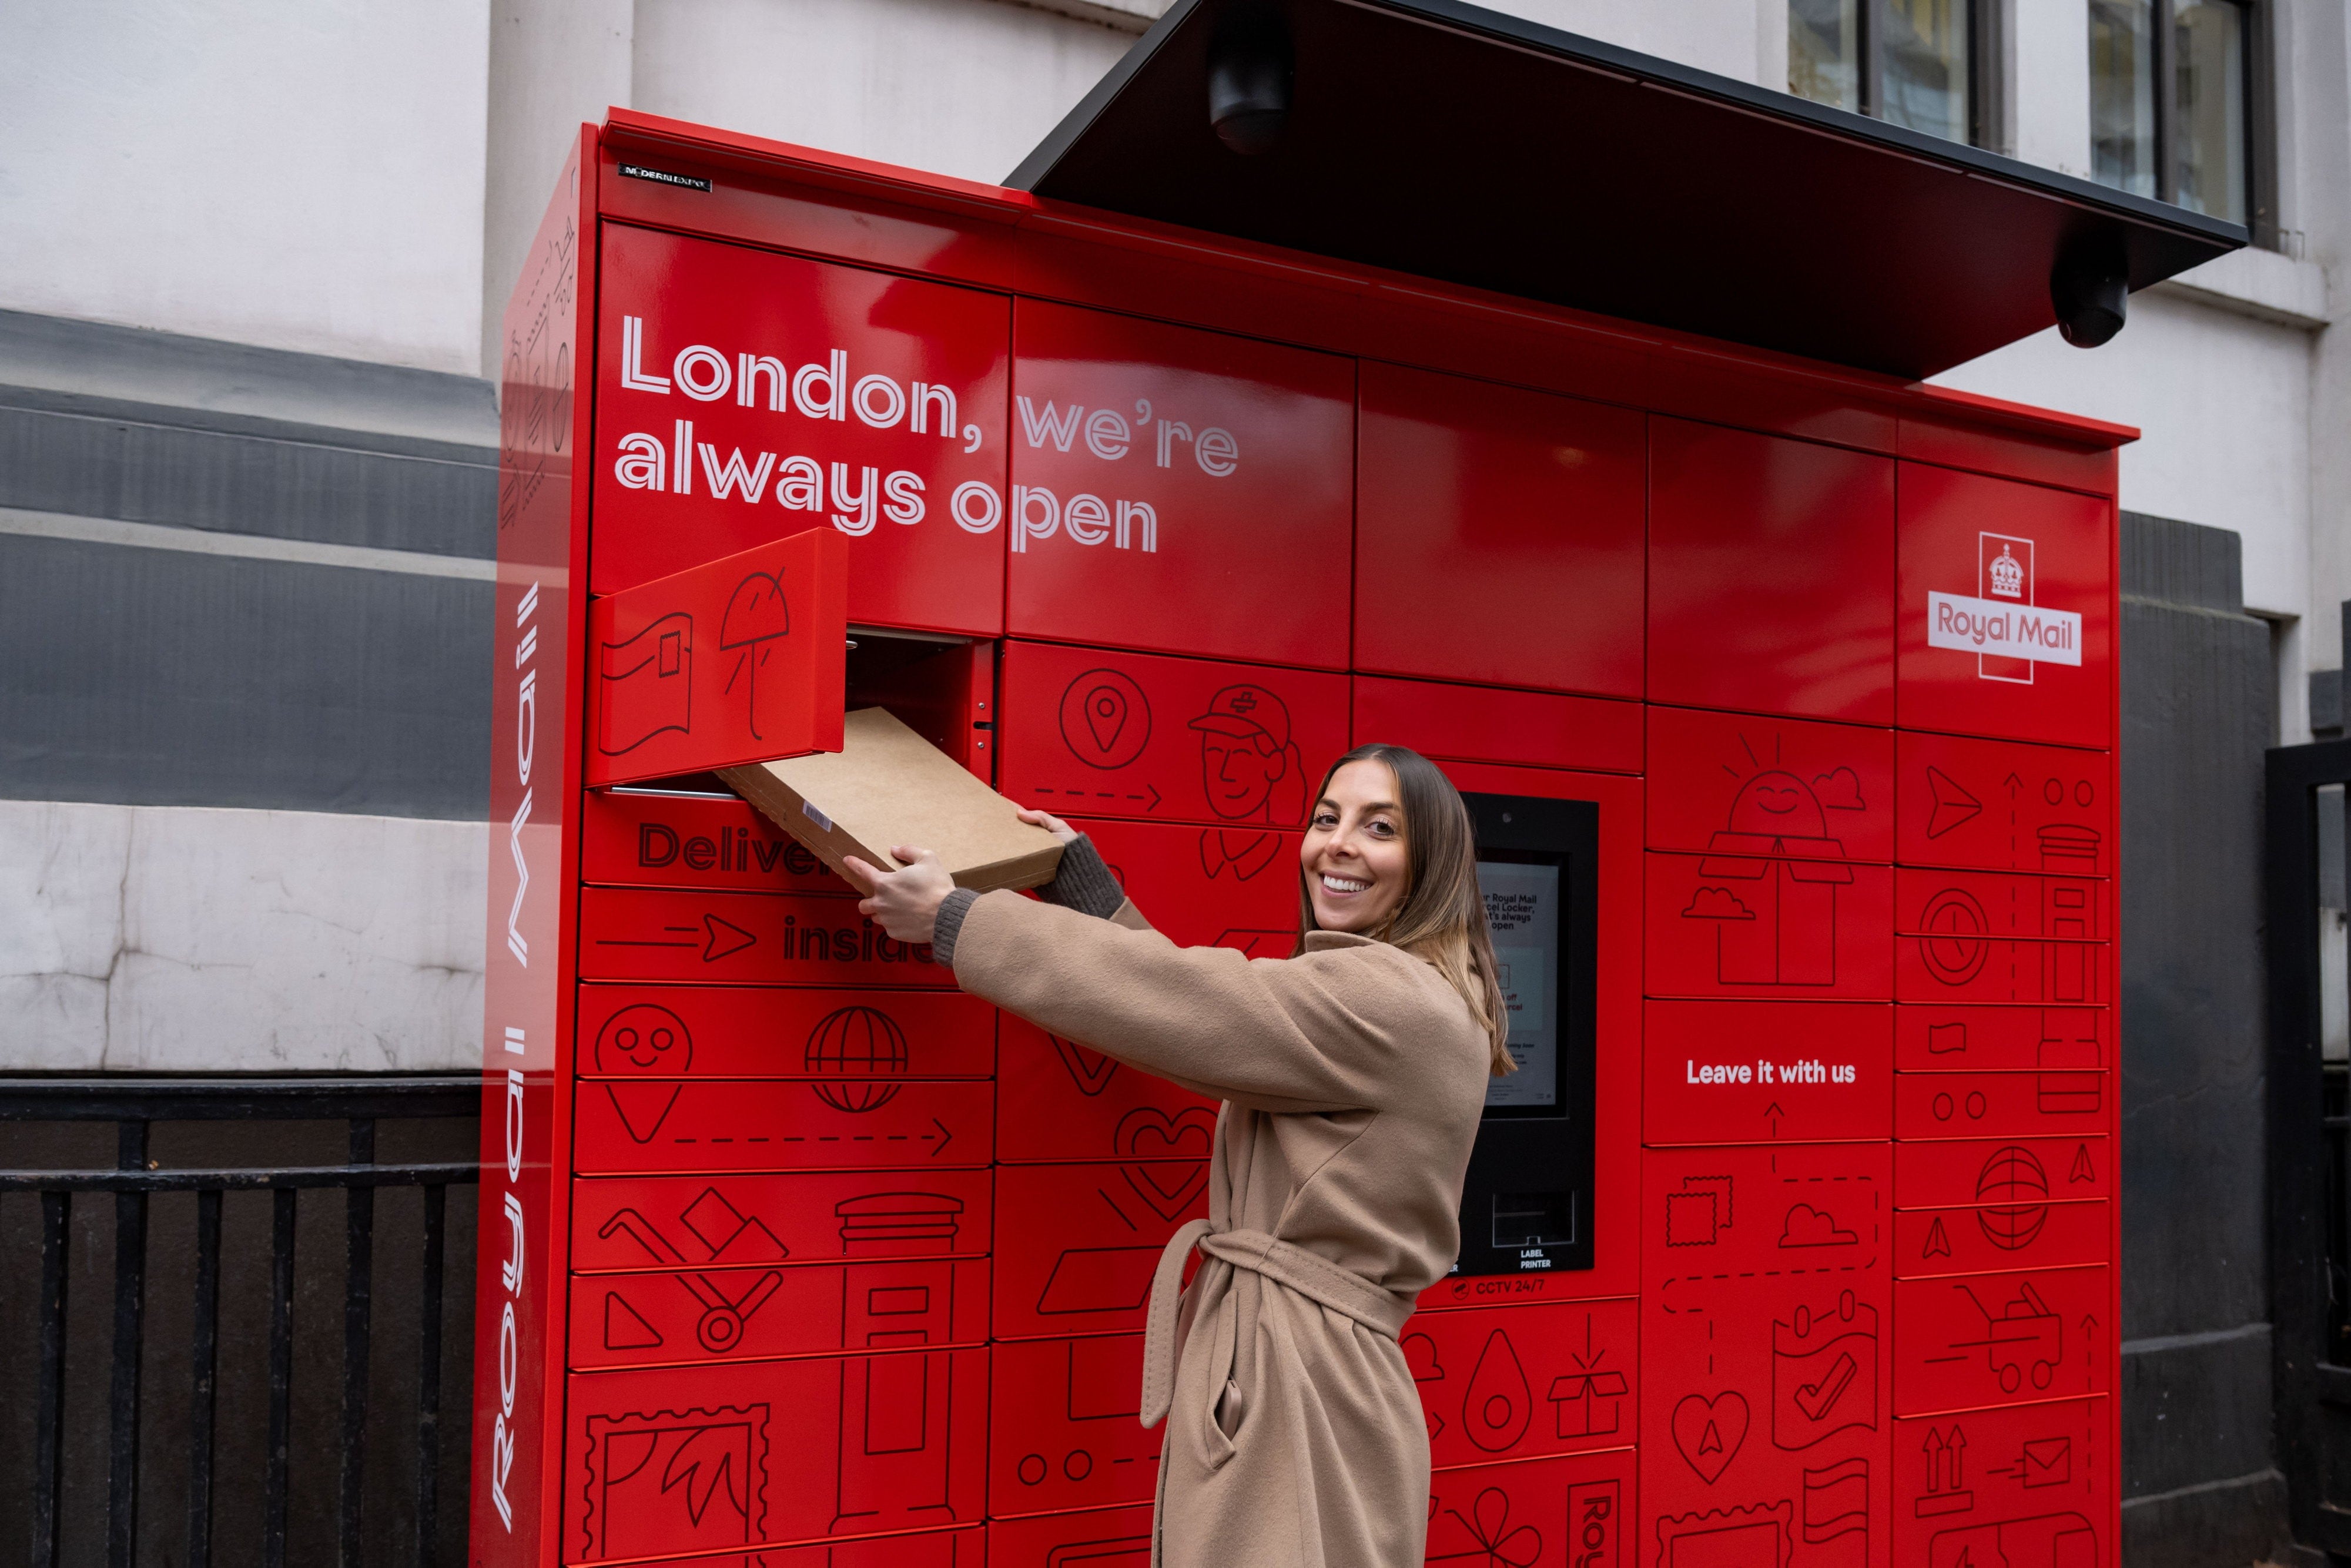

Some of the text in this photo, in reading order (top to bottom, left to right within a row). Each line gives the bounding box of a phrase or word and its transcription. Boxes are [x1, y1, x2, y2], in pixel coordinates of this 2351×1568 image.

[621, 316, 1239, 477] London, we're
[614, 419, 1157, 554] always open
[1938, 602, 2072, 650] Royal Mail
[1492, 893, 1516, 904] Royal
[1519, 894, 1537, 903] Mail
[1502, 904, 1535, 913] Locker,
[1502, 913, 1531, 923] always
[491, 581, 538, 1534] Royal Mail
[1687, 1059, 1856, 1084] Leave it with us
[1521, 1249, 1544, 1258] LABEL
[1521, 1259, 1552, 1269] PRINTER
[1476, 1278, 1545, 1294] CCTV 24/7
